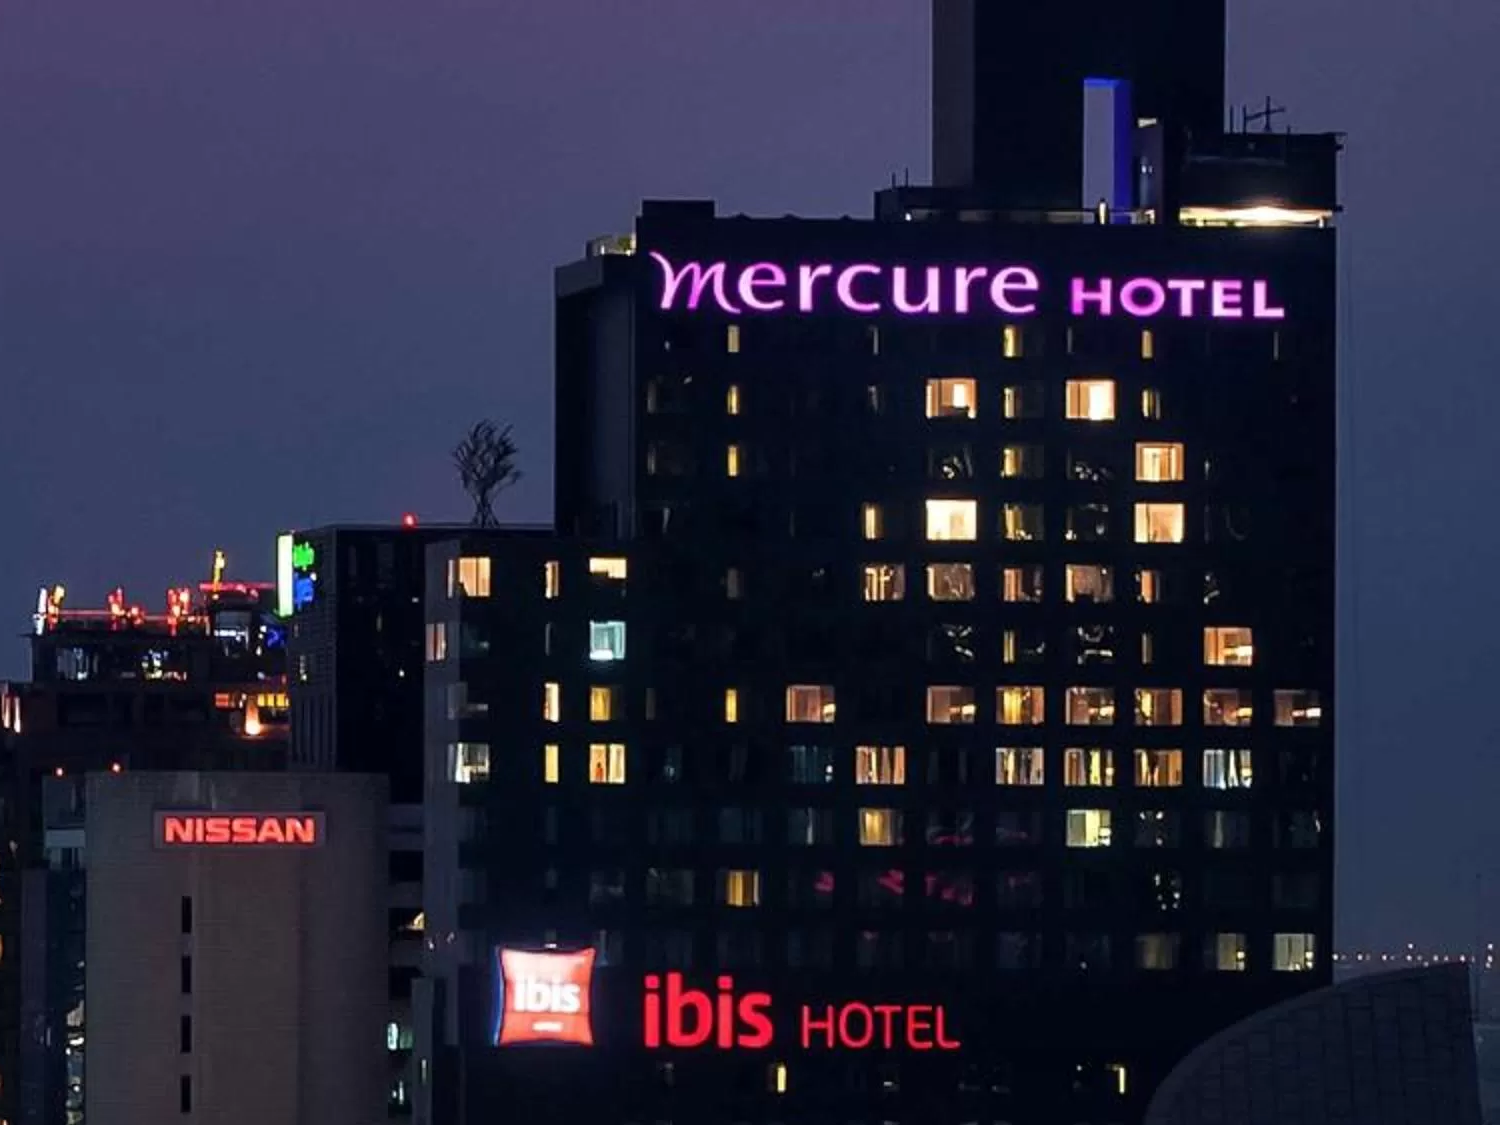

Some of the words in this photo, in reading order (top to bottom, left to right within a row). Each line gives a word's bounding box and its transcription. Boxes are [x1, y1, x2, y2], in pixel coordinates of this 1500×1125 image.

[649, 251, 1040, 315] mercure
[1071, 277, 1285, 318] HOTEL
[164, 817, 315, 843] NISSAN
[513, 974, 581, 1014] ibis
[644, 972, 773, 1049] ibis
[802, 1002, 961, 1049] HOTEL
